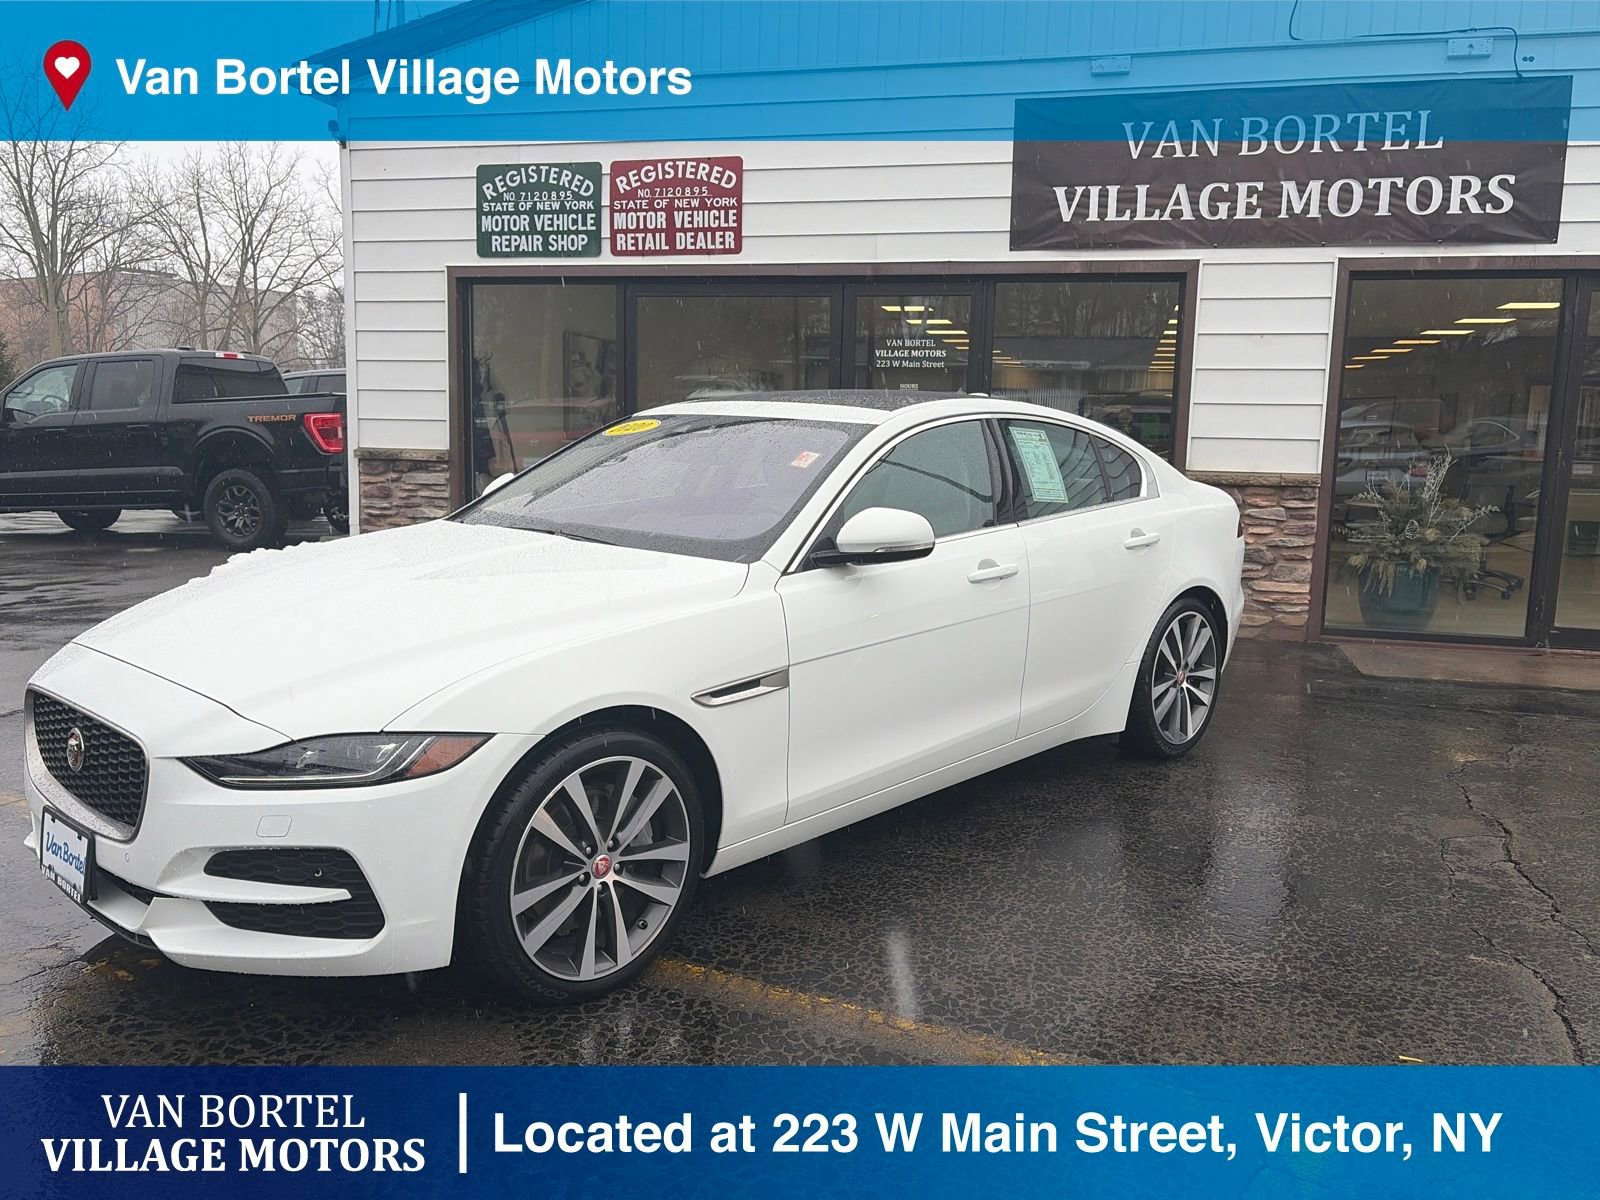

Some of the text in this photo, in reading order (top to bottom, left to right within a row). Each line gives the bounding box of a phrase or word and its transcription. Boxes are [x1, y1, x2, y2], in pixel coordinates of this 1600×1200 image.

[1121, 109, 1445, 160] VAN BORTEL
[482, 164, 595, 201] REGISTERED
[615, 161, 737, 194] REGISTERED
[519, 190, 573, 201] 7120895
[653, 186, 709, 198] 7120895
[1052, 173, 1517, 223] VILLAGE MOTORS
[482, 200, 594, 212] STATE OF NEW YORK
[613, 197, 738, 210] STATE OF NEW YORK
[481, 213, 597, 232] MOTOR VEHICLE
[613, 210, 738, 230] MOTOR VEHICLE
[491, 233, 588, 252] REPAIR SHOP
[616, 231, 735, 251] RETAIL DEALER
[886, 339, 936, 347] VAN BORTEL
[875, 349, 947, 358] VILLAGE MOTORS
[876, 360, 945, 368] 223 W Main Street
[247, 414, 297, 423] TREMOR
